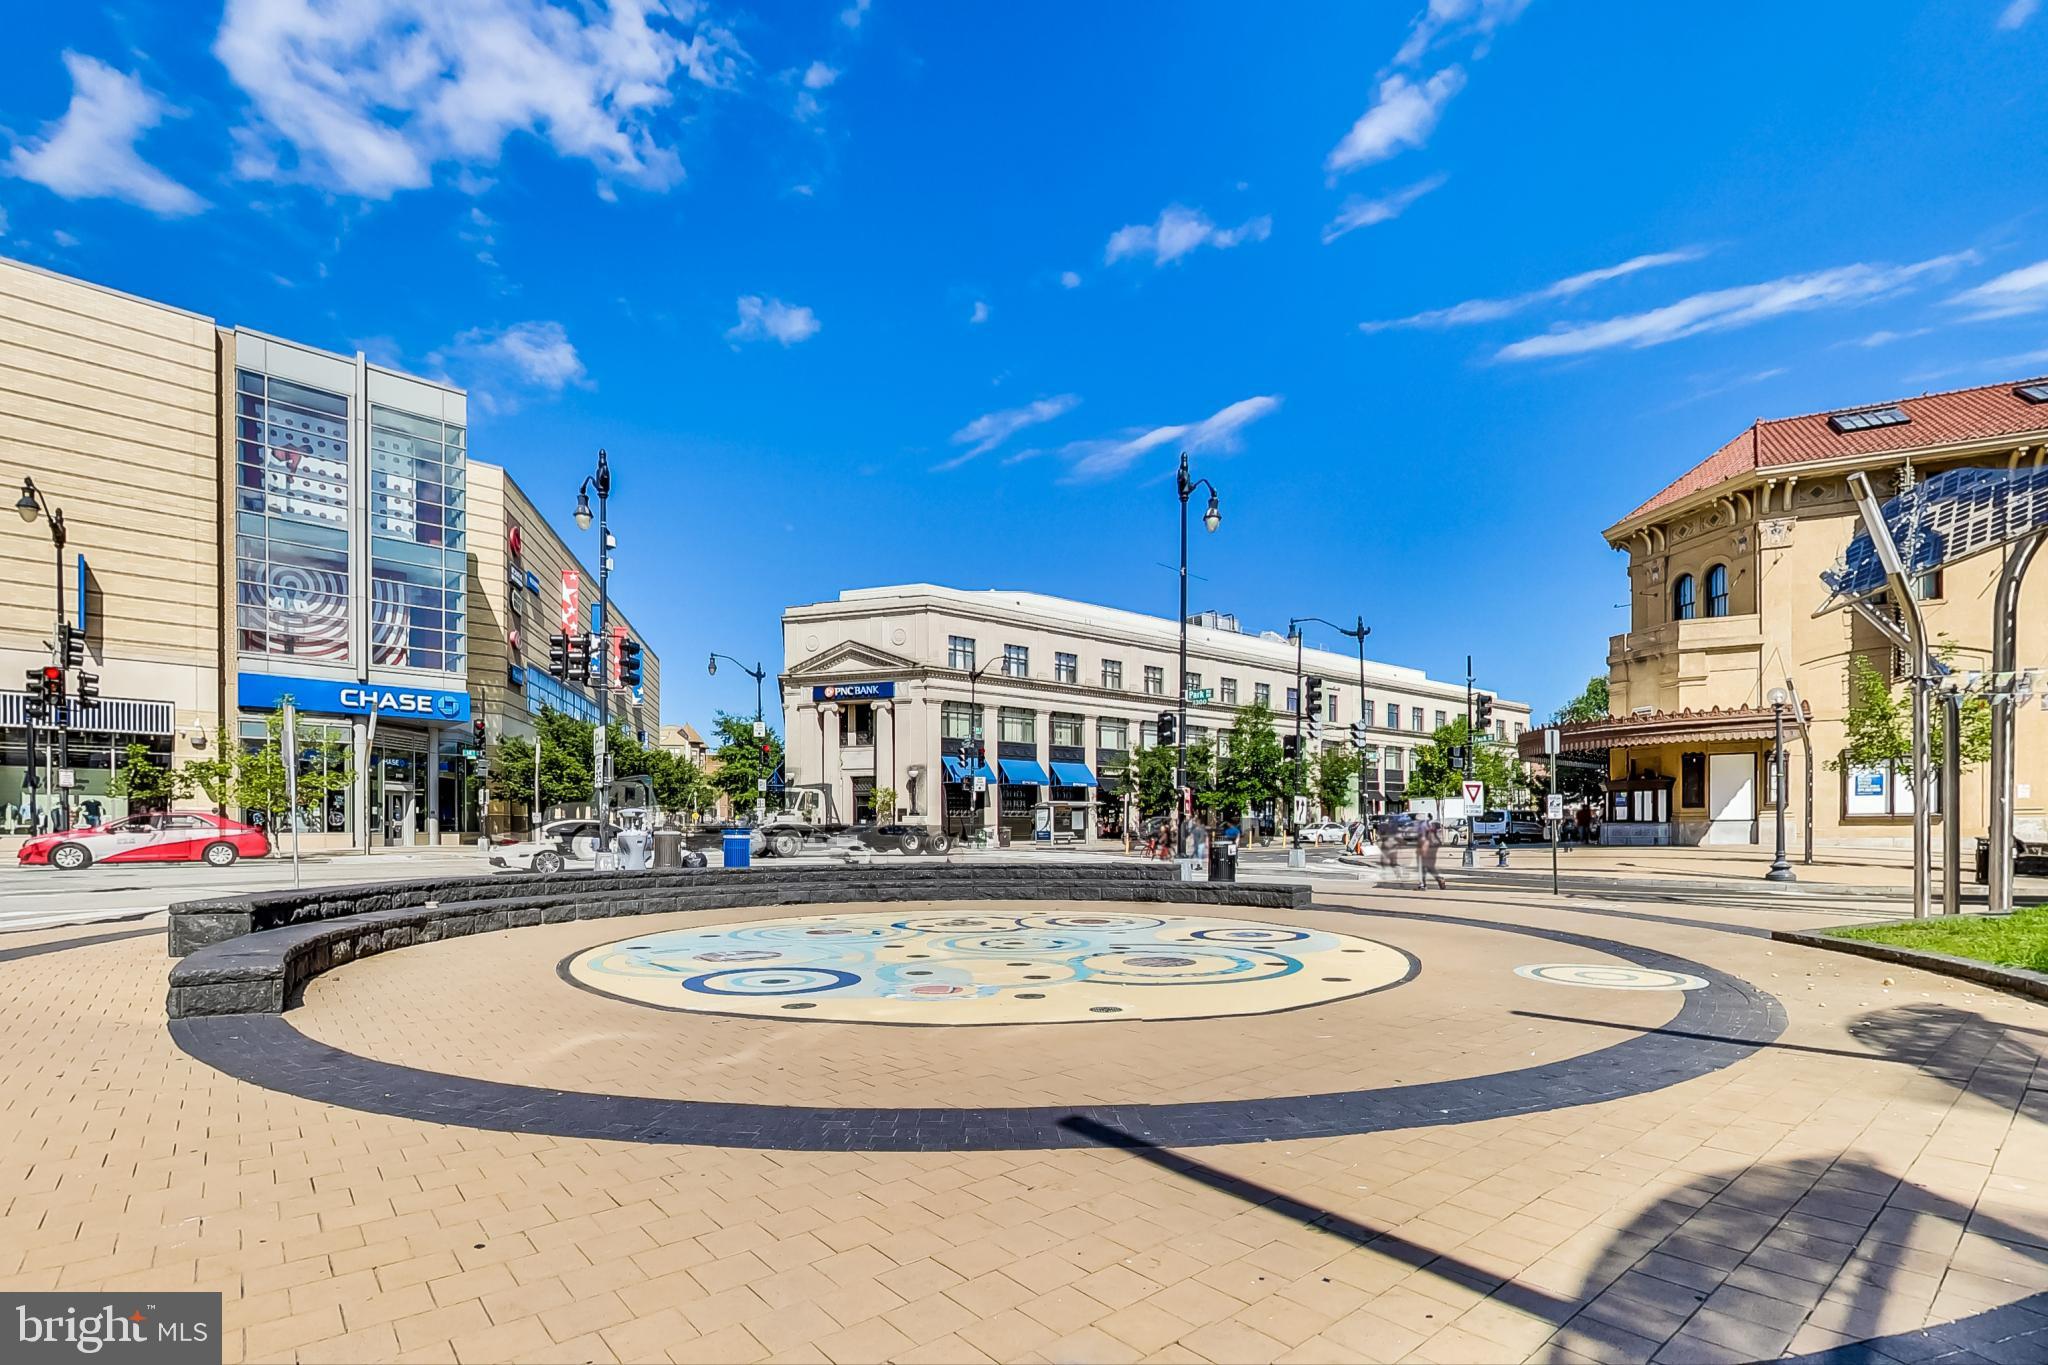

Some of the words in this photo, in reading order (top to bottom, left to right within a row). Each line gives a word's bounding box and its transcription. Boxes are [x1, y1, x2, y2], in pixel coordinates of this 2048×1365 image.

[835, 686, 853, 697] PNC
[854, 685, 879, 695] BANK
[1189, 690, 1204, 699] Park
[340, 688, 434, 713] CHASE
